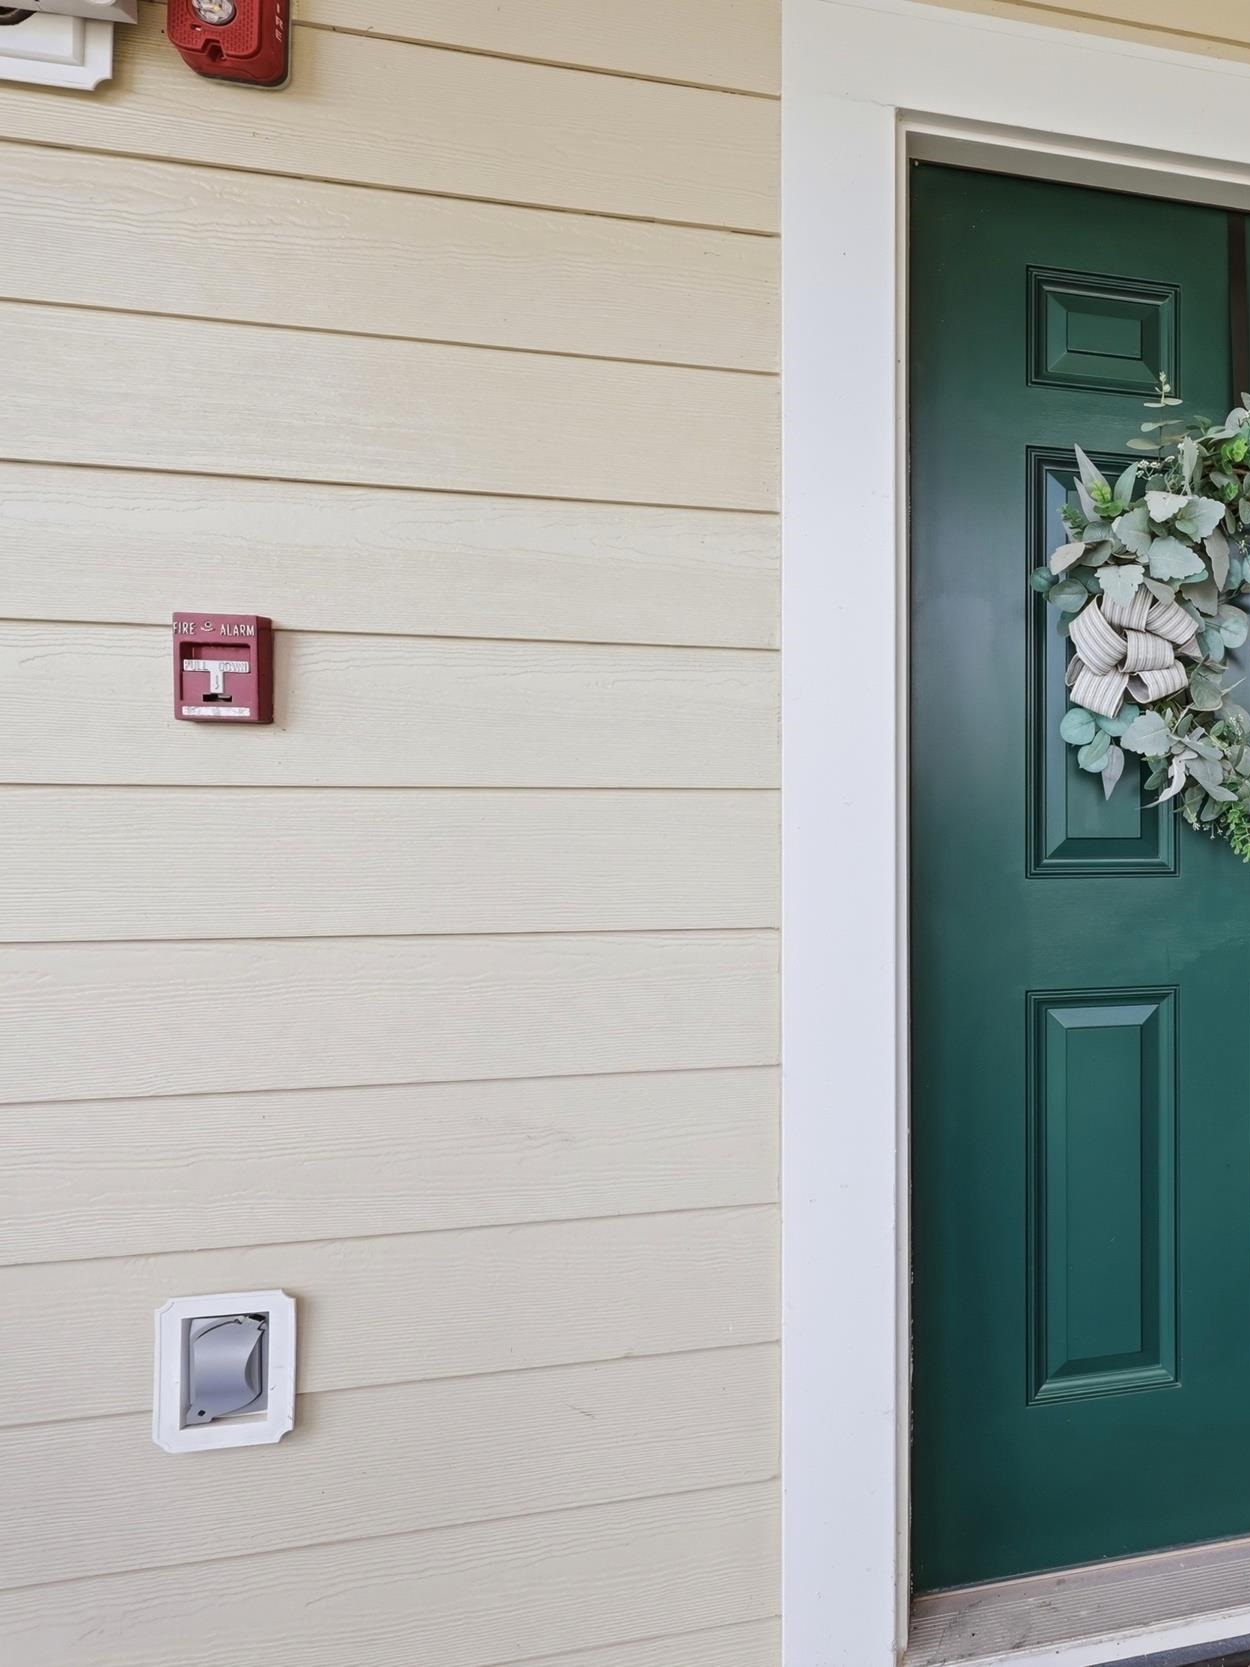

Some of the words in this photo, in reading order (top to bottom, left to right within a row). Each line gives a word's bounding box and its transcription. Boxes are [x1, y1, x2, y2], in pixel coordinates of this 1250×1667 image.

[275, 3, 283, 42] IRE
[173, 621, 196, 635] FIRE
[219, 623, 255, 637] ALARM
